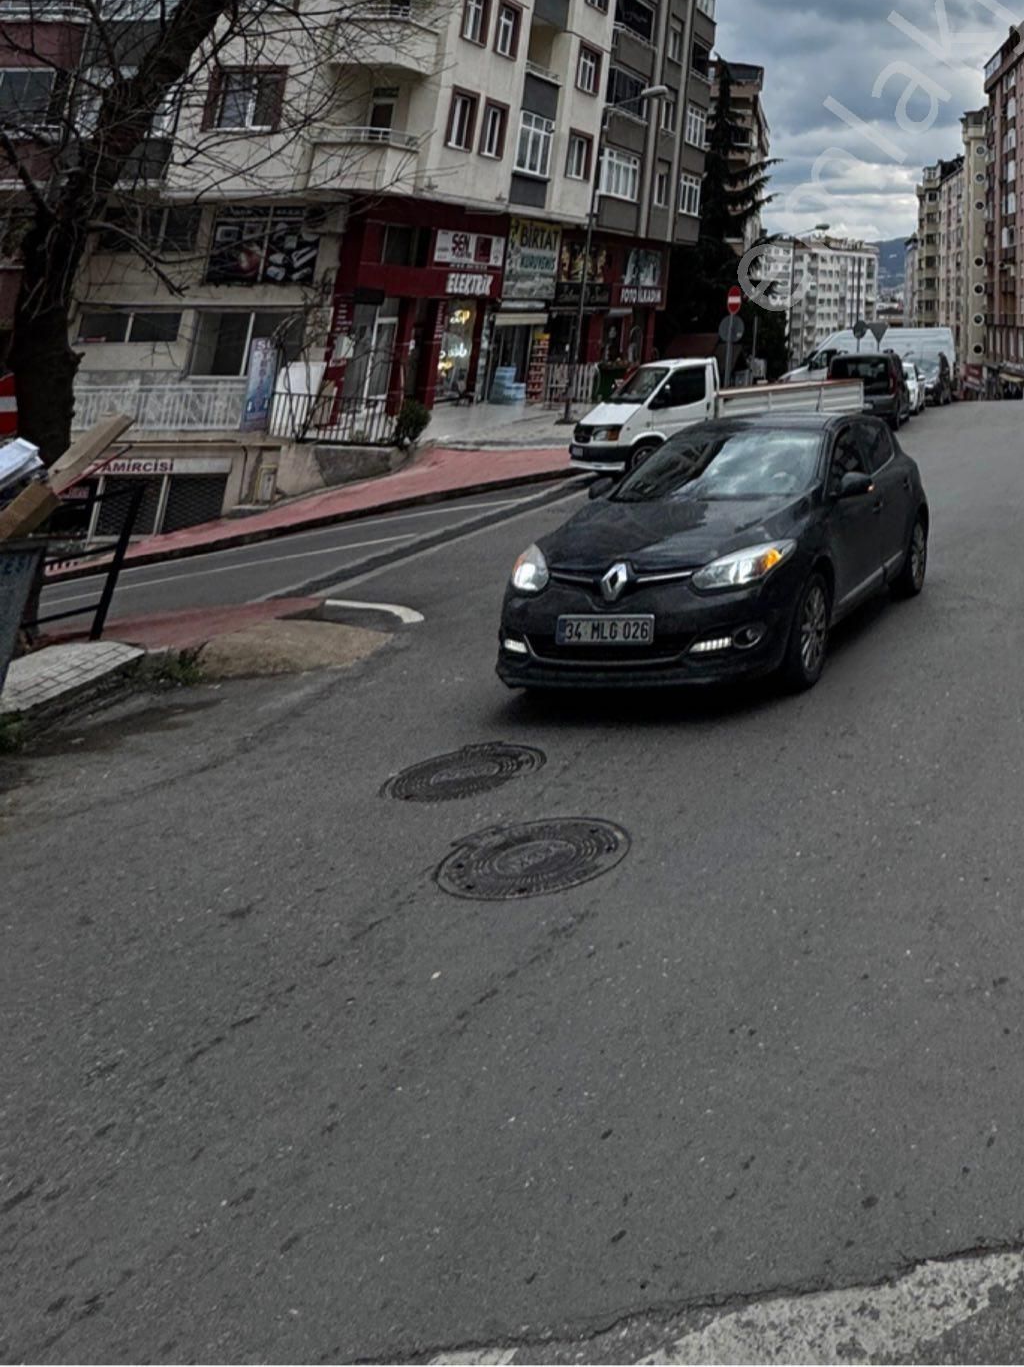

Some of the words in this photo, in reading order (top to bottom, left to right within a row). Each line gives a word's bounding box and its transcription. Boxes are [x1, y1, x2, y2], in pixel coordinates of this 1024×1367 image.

[446, 273, 494, 295] ELEKTRİK
[620, 288, 637, 303] FOTO
[565, 622, 582, 639] 34
[591, 621, 618, 639] MLG
[623, 621, 649, 639] 026
